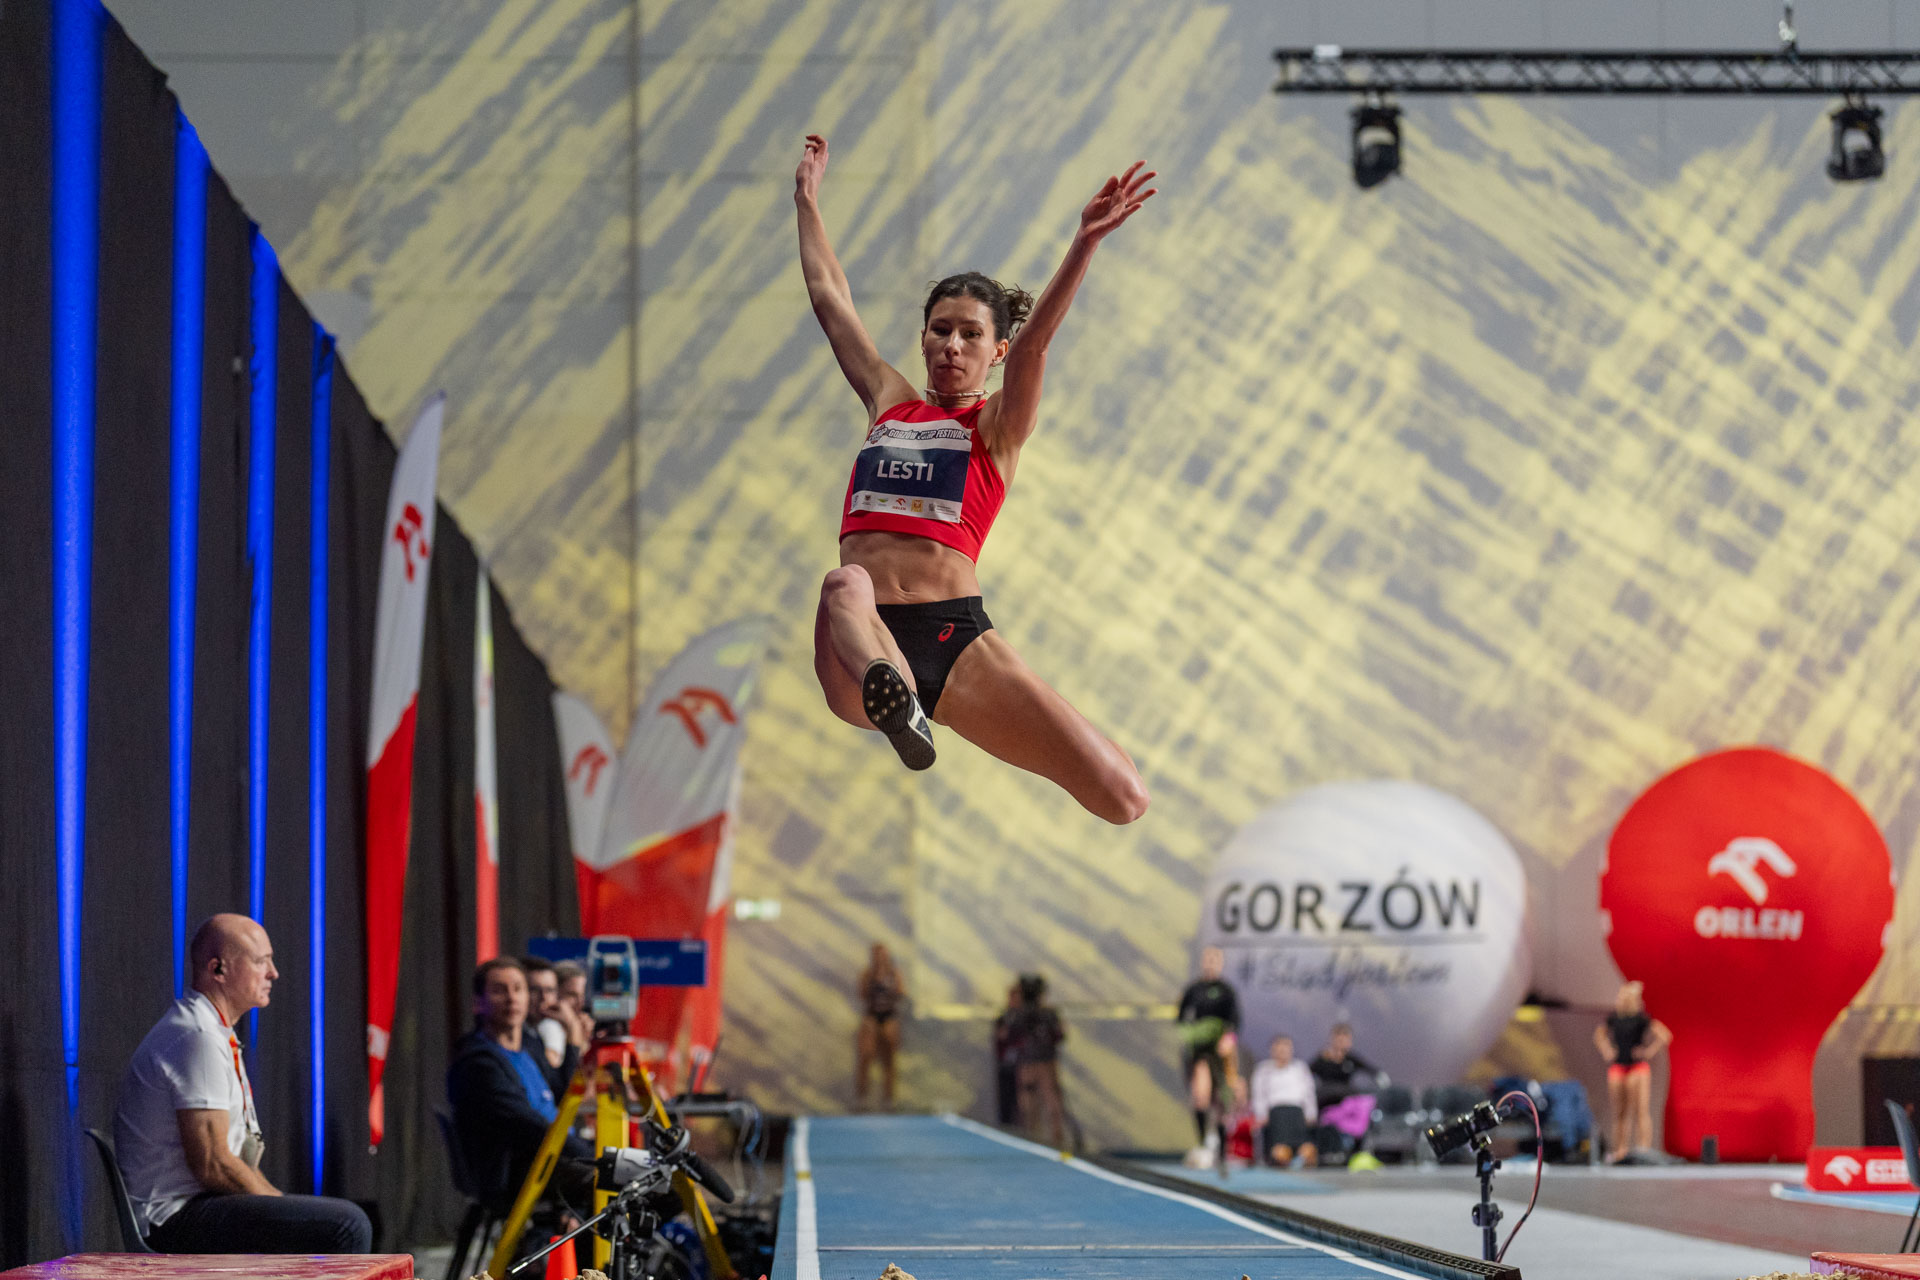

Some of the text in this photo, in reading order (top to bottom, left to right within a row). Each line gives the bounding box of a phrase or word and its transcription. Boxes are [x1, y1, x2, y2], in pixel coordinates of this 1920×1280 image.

[936, 428, 966, 440] FESTIVAL
[877, 459, 934, 481] LESTI
[1215, 864, 1481, 933] GORZÓW
[1694, 905, 1805, 941] ORLEN
